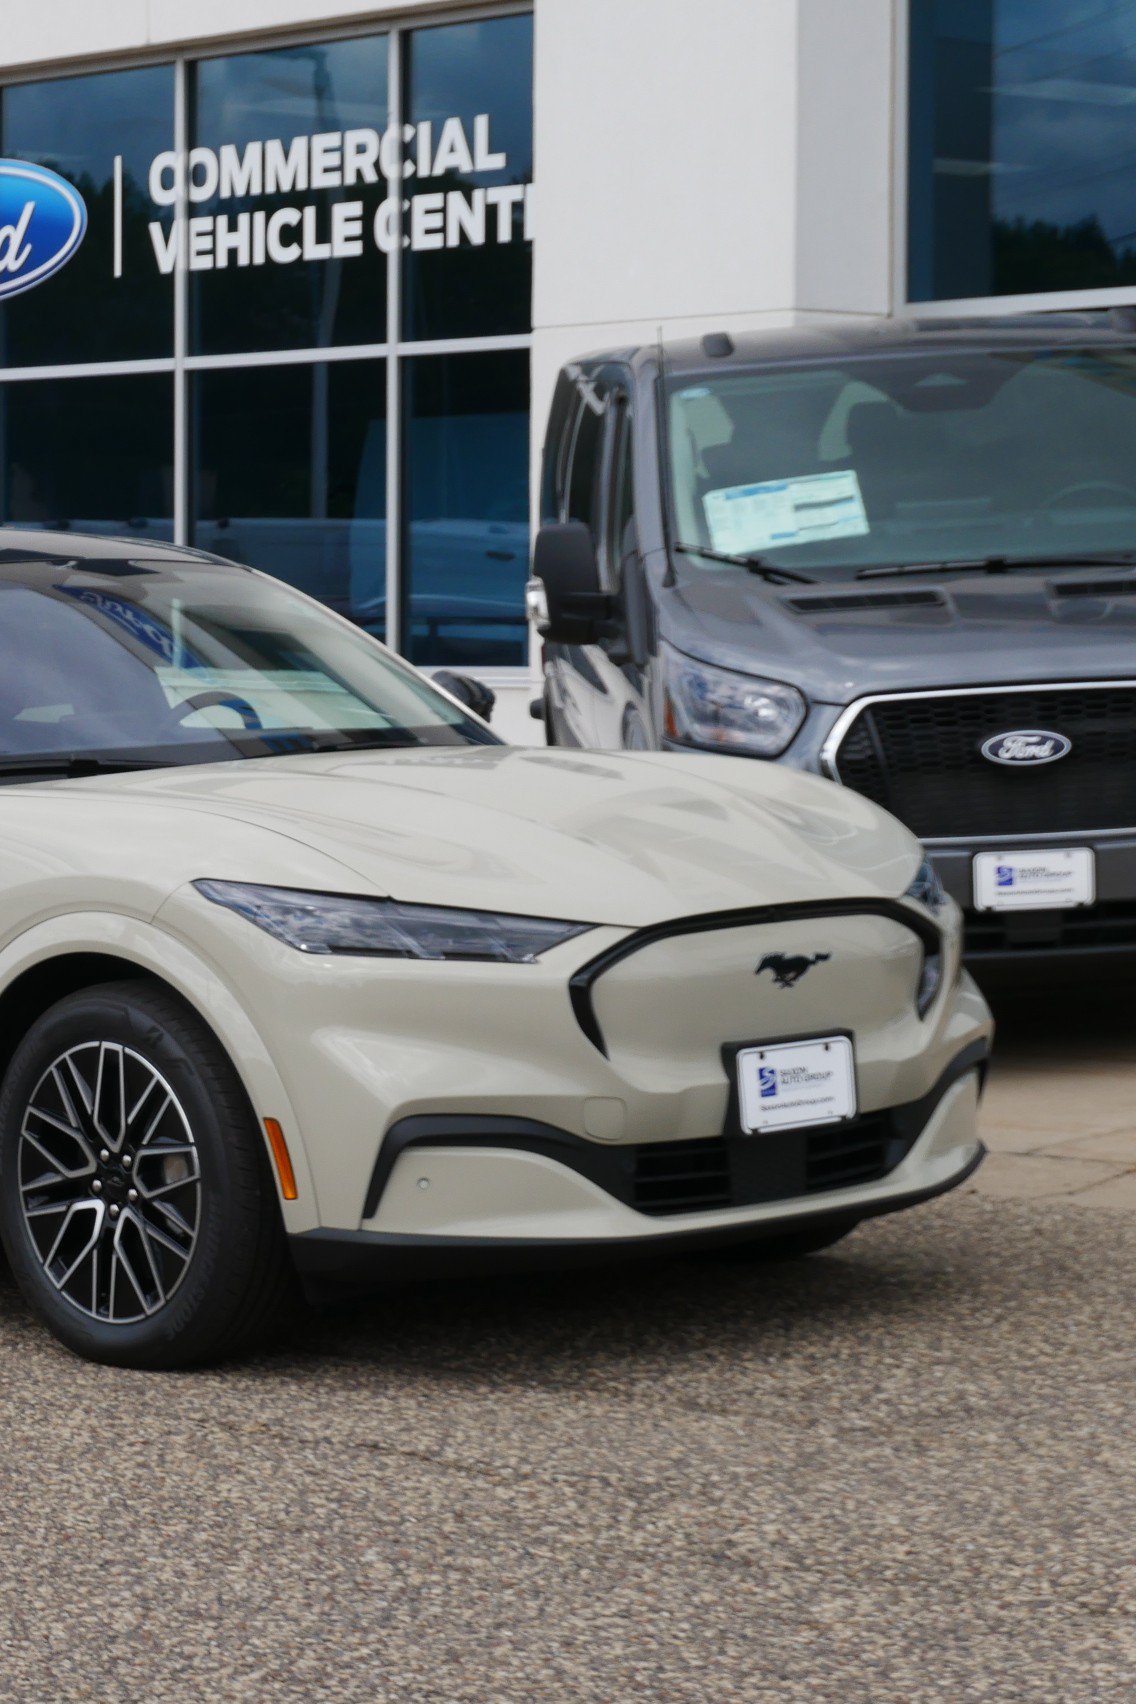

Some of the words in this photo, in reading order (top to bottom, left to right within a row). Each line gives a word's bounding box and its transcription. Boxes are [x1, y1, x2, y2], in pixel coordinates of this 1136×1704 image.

[149, 114, 506, 206] COMMERCIAL
[148, 201, 363, 275] VEHICLE
[998, 735, 1055, 760] Ford
